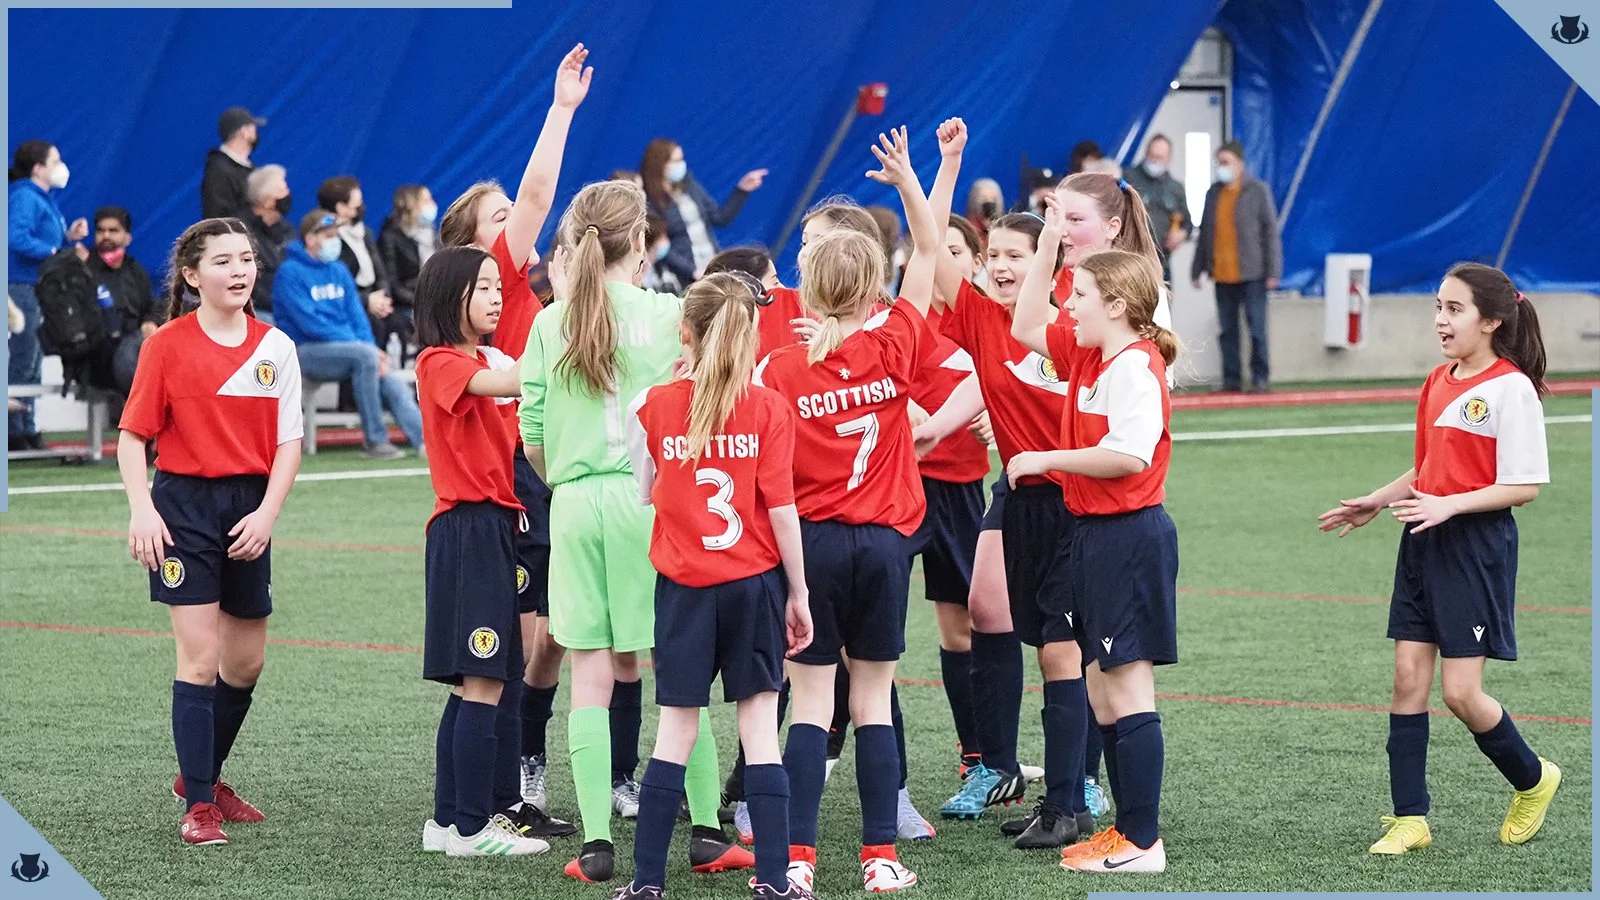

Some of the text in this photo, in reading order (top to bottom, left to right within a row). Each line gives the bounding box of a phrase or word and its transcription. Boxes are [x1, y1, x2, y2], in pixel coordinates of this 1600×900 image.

[797, 377, 897, 419] SCOTTISH
[662, 433, 759, 460] SCTTISH
[835, 412, 880, 491] 7
[695, 467, 743, 550] 3
